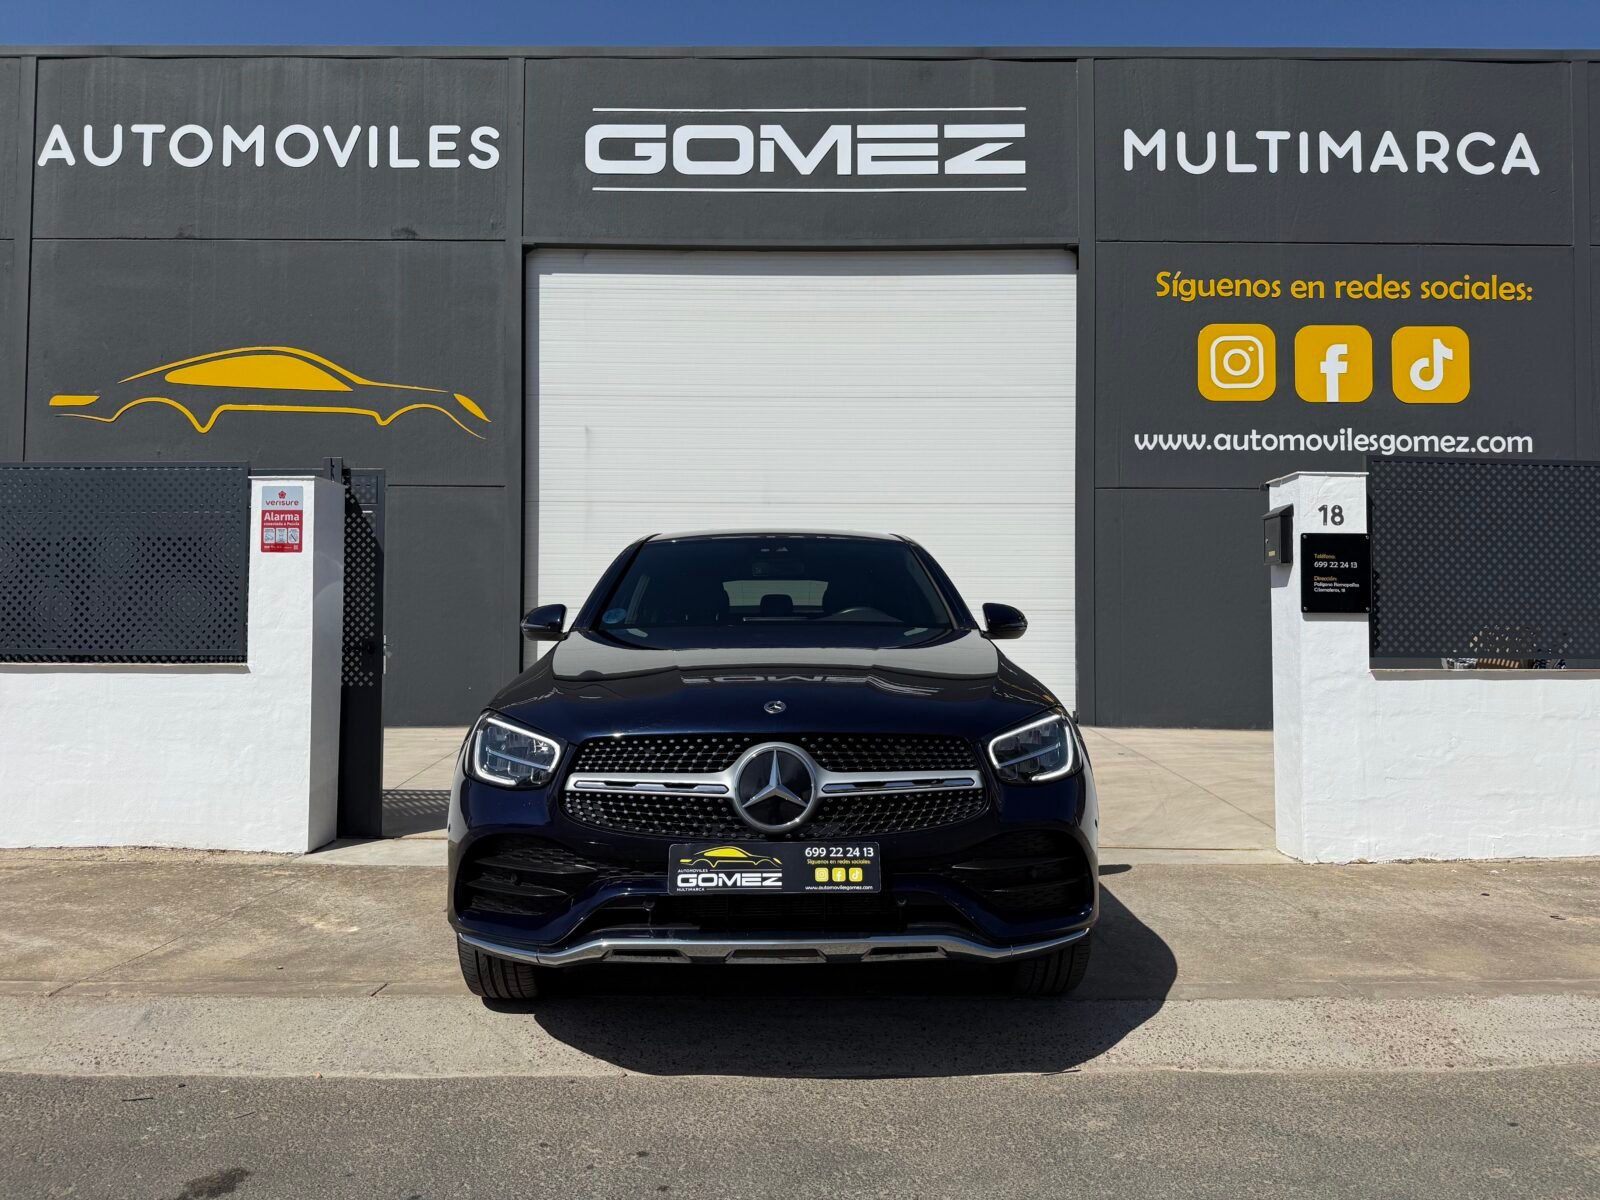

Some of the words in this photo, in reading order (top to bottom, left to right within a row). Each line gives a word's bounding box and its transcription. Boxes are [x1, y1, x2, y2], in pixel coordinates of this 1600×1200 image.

[37, 123, 500, 170] AUTOMOVILES
[584, 123, 1026, 176] GOMEZ
[1123, 128, 1540, 176] MULTIMARCA
[1155, 271, 1282, 303] Síguenos
[1289, 279, 1326, 300] en
[1334, 273, 1412, 300] redes
[1420, 274, 1533, 302] sociales:
[1134, 427, 1533, 456] www.automovilesgomez.com
[263, 512, 300, 521] Alarma
[1317, 504, 1345, 526] 18
[1340, 561, 1349, 569] 24
[805, 847, 827, 858] 699
[829, 847, 844, 858] 22
[846, 847, 861, 858] 24
[863, 847, 874, 858] 13
[677, 872, 783, 887] GOMEZ
